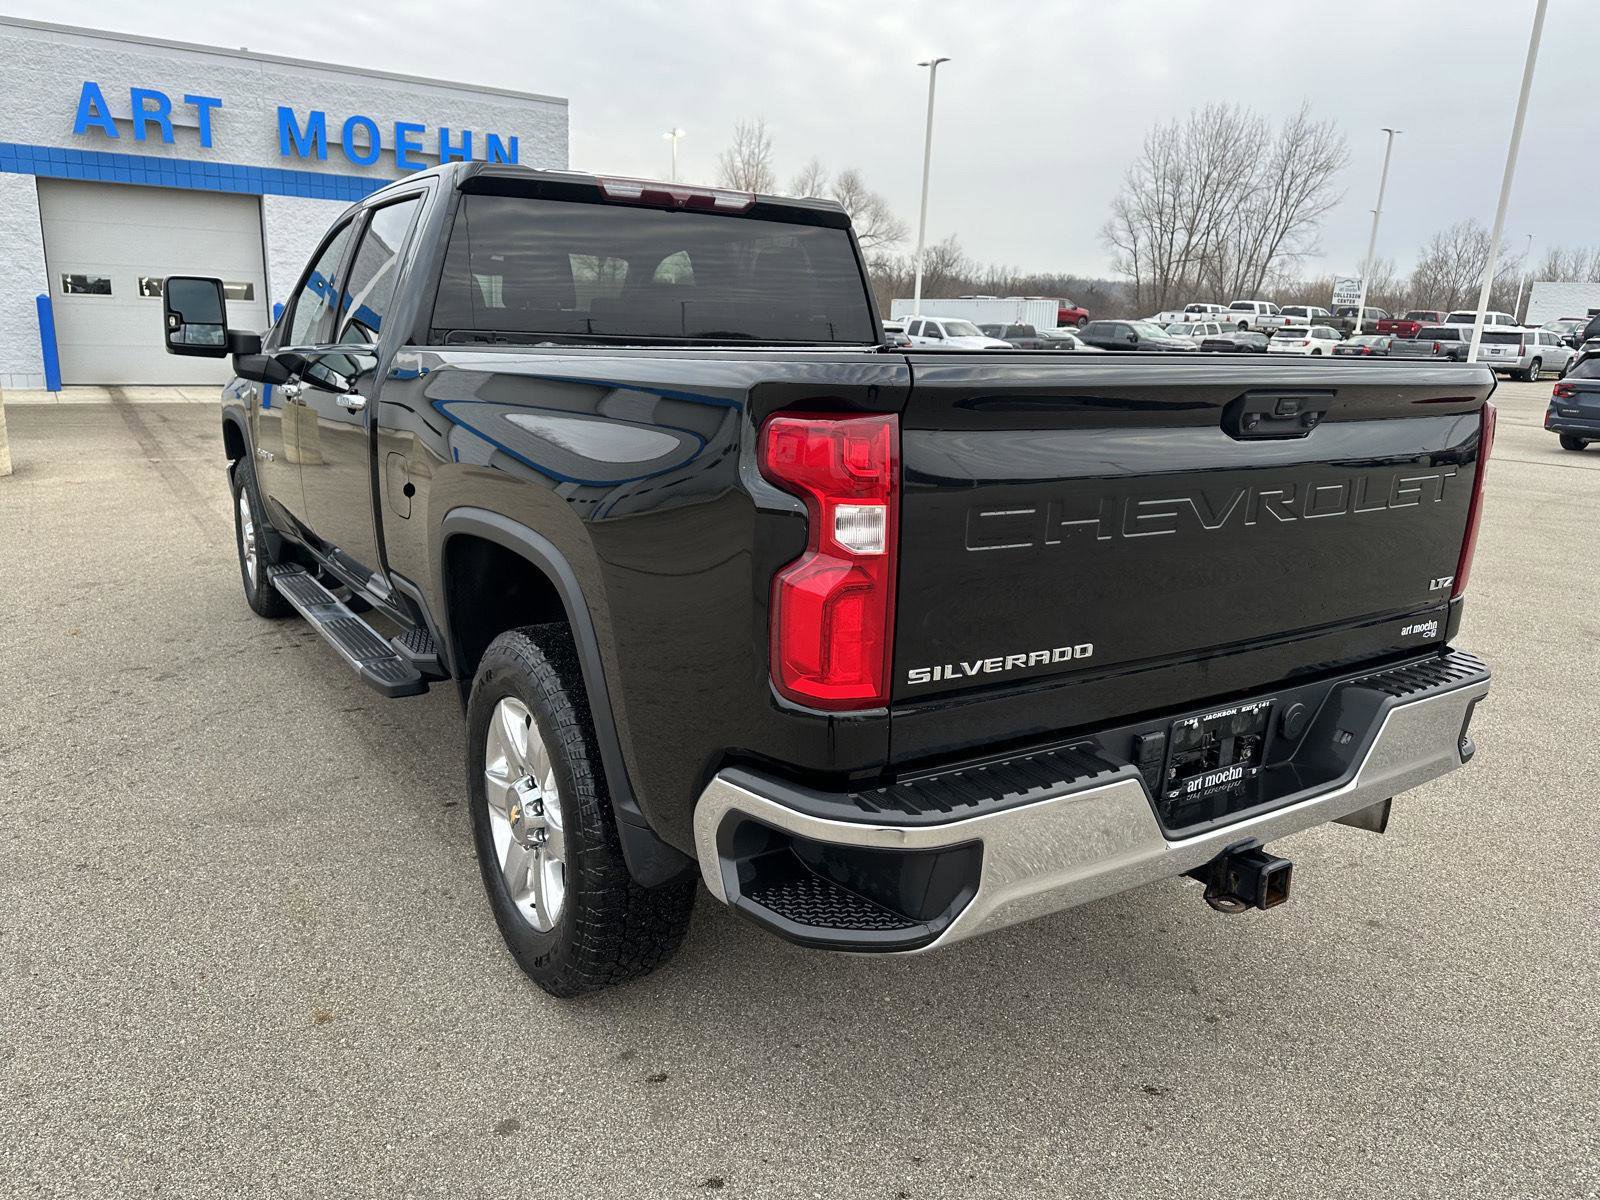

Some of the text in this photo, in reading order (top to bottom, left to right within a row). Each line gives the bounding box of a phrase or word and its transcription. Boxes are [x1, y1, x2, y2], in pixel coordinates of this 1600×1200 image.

[73, 81, 519, 170] ART MOEHN
[965, 469, 1458, 551] CHEVROLET
[1429, 576, 1454, 591] LTZ
[1401, 620, 1438, 636] art moehn
[907, 643, 1094, 685] SILVERADO
[1203, 708, 1237, 721] JACKSON
[1241, 704, 1257, 712] EXIT
[1187, 766, 1243, 793] art moehn
